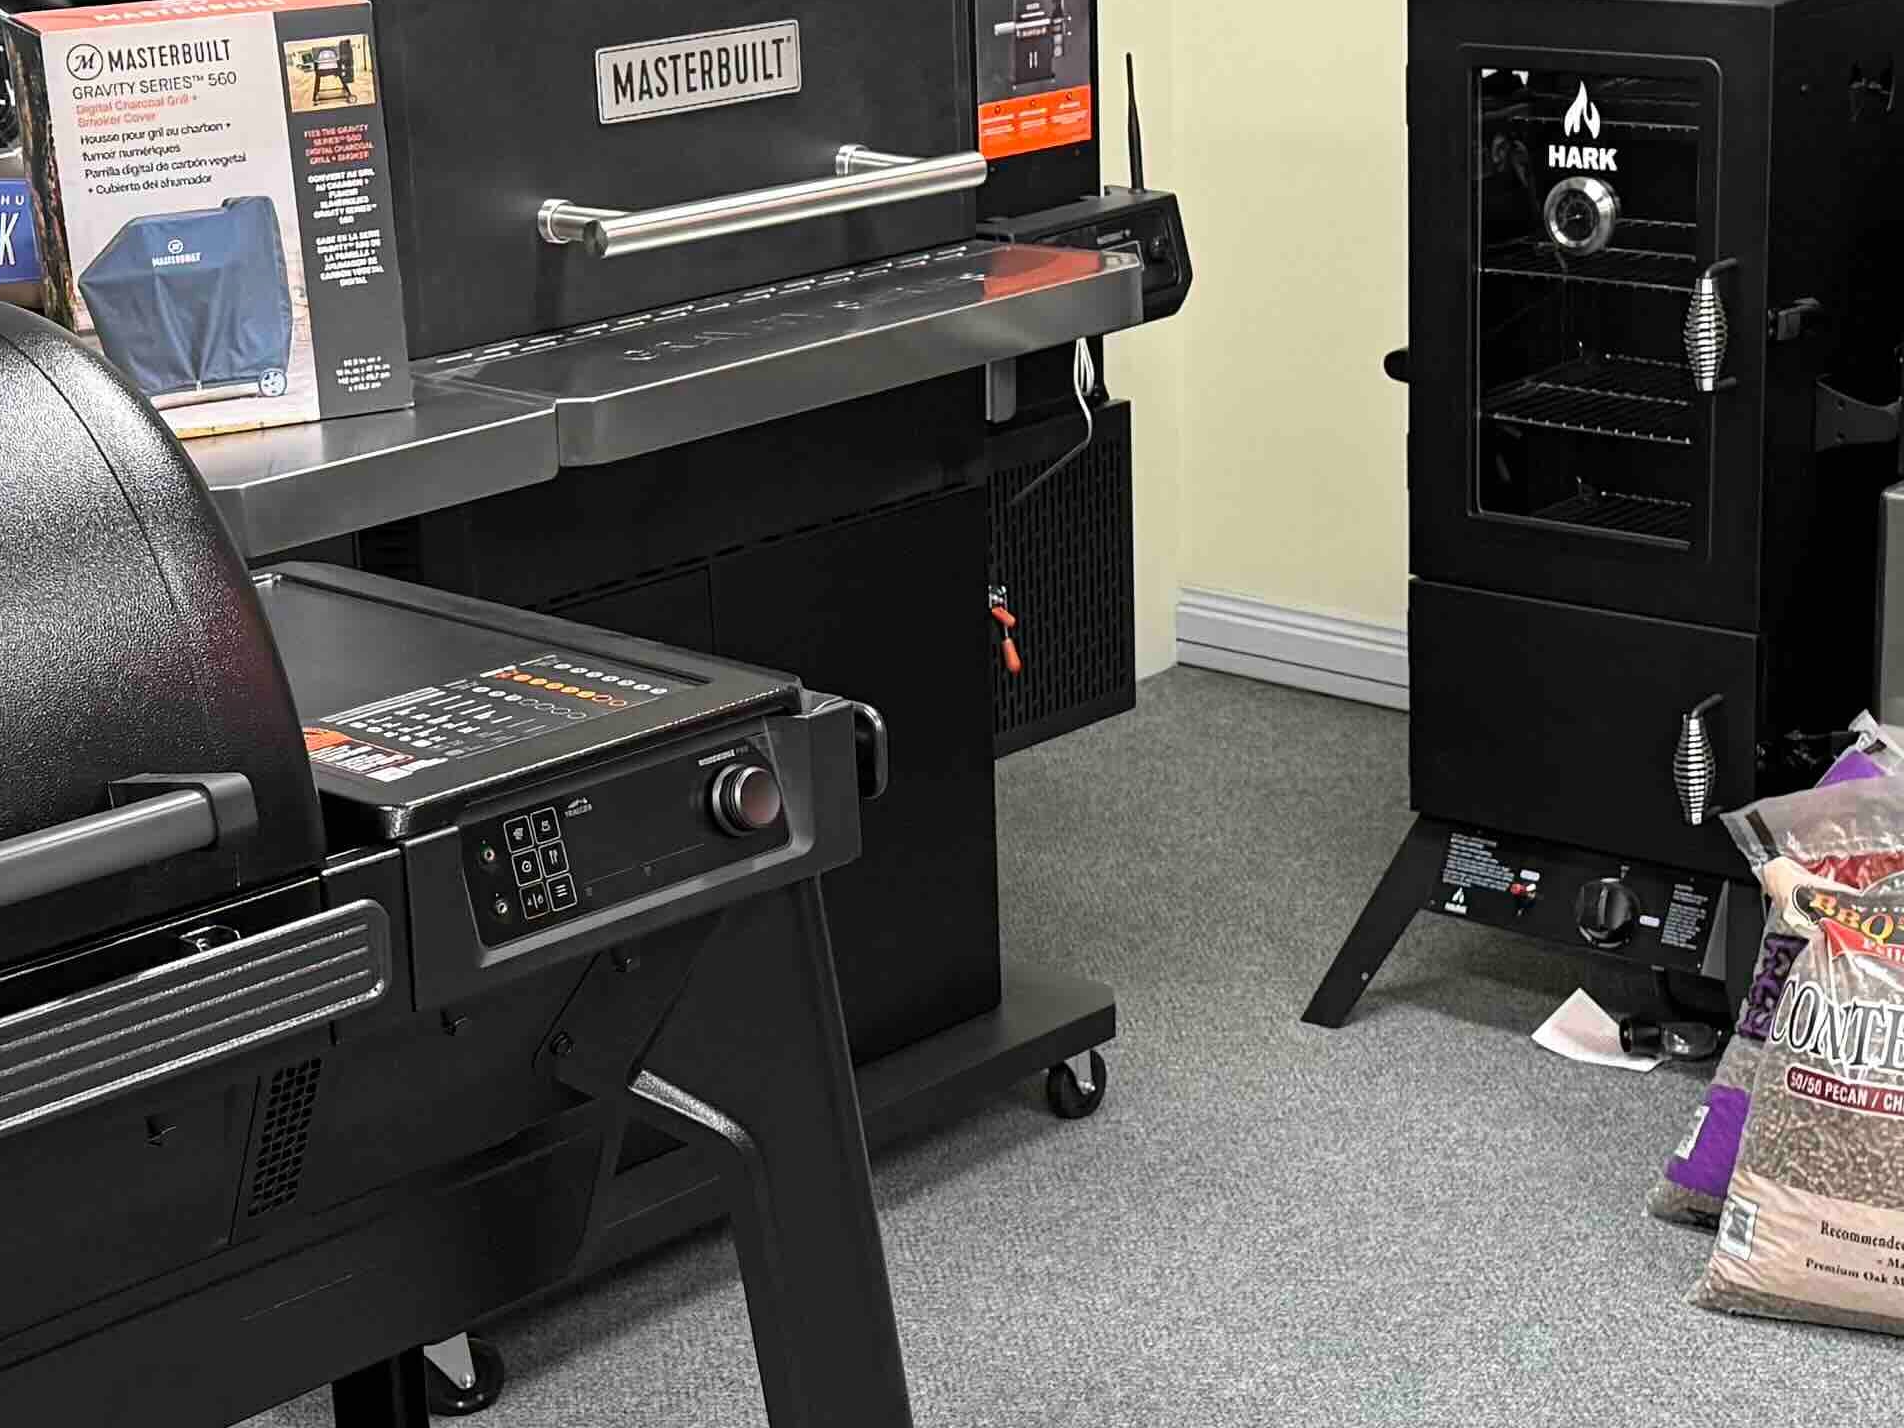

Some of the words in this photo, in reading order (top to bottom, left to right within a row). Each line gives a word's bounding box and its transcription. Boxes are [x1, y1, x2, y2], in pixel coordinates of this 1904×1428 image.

[108, 39, 231, 72] MASTERBUILT
[610, 37, 786, 105] MASTERBUILT
[72, 80, 135, 100] GRAVITY
[208, 71, 237, 87] 560
[76, 99, 112, 115] Digital
[115, 96, 164, 111] Charcoal
[167, 93, 189, 106] Grill
[78, 115, 121, 128] Smoker
[124, 112, 156, 124] Cover
[80, 132, 119, 145] Housse
[122, 131, 145, 143] pour
[167, 129, 179, 137] au
[181, 123, 224, 135] charbon
[156, 162, 169, 172] de
[209, 154, 246, 169] vegetal
[1549, 144, 1618, 171] HARK
[143, 178, 158, 190] del
[161, 175, 212, 188] ahumador
[1790, 1074, 1823, 1097] 50/50
[1825, 1082, 1868, 1107] PECAN
[1806, 1258, 1860, 1280] Premium
[1863, 1270, 1889, 1286] Oak
